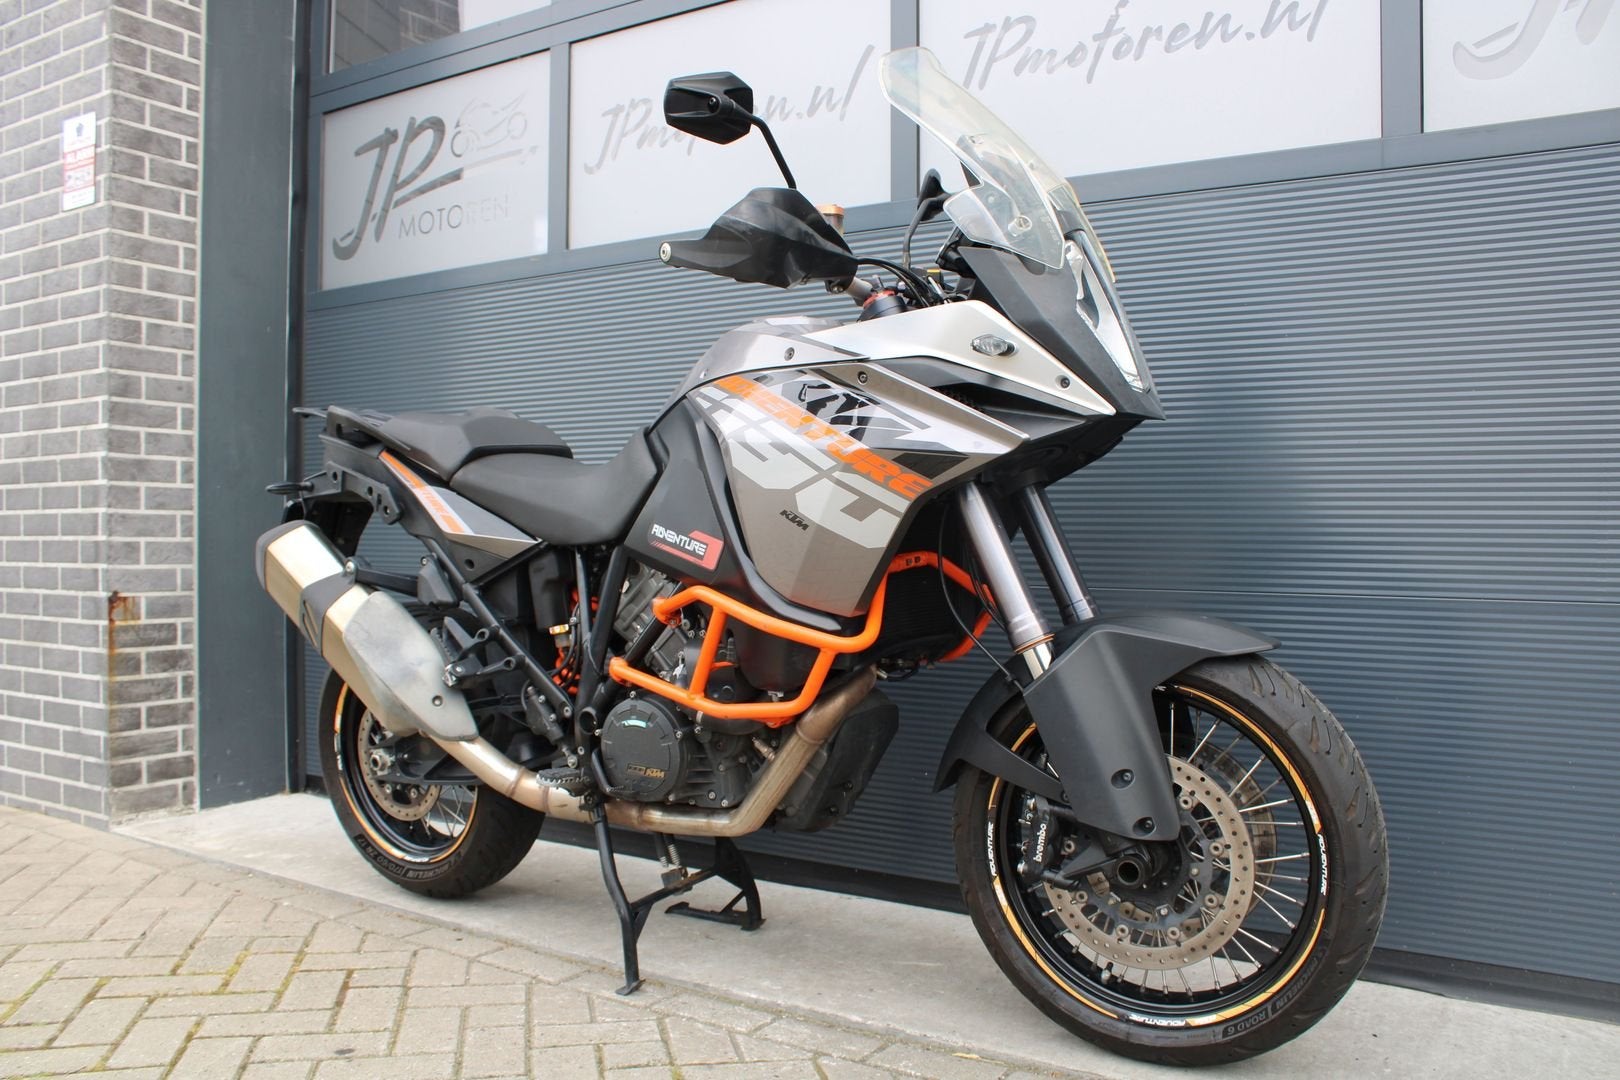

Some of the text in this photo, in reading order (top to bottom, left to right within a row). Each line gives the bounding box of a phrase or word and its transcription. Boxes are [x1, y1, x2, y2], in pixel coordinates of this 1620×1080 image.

[584, 44, 875, 175] JPmn.nl
[398, 193, 510, 240] MOTOREN
[651, 523, 707, 556] ADVENTURE
[779, 509, 809, 531] KTM
[987, 821, 998, 877] ADVENTURE
[1033, 823, 1047, 863] brembo
[1317, 833, 1328, 896] ADVENTURE
[1226, 1025, 1236, 1036] 6
[1237, 1010, 1266, 1031] ROAD
